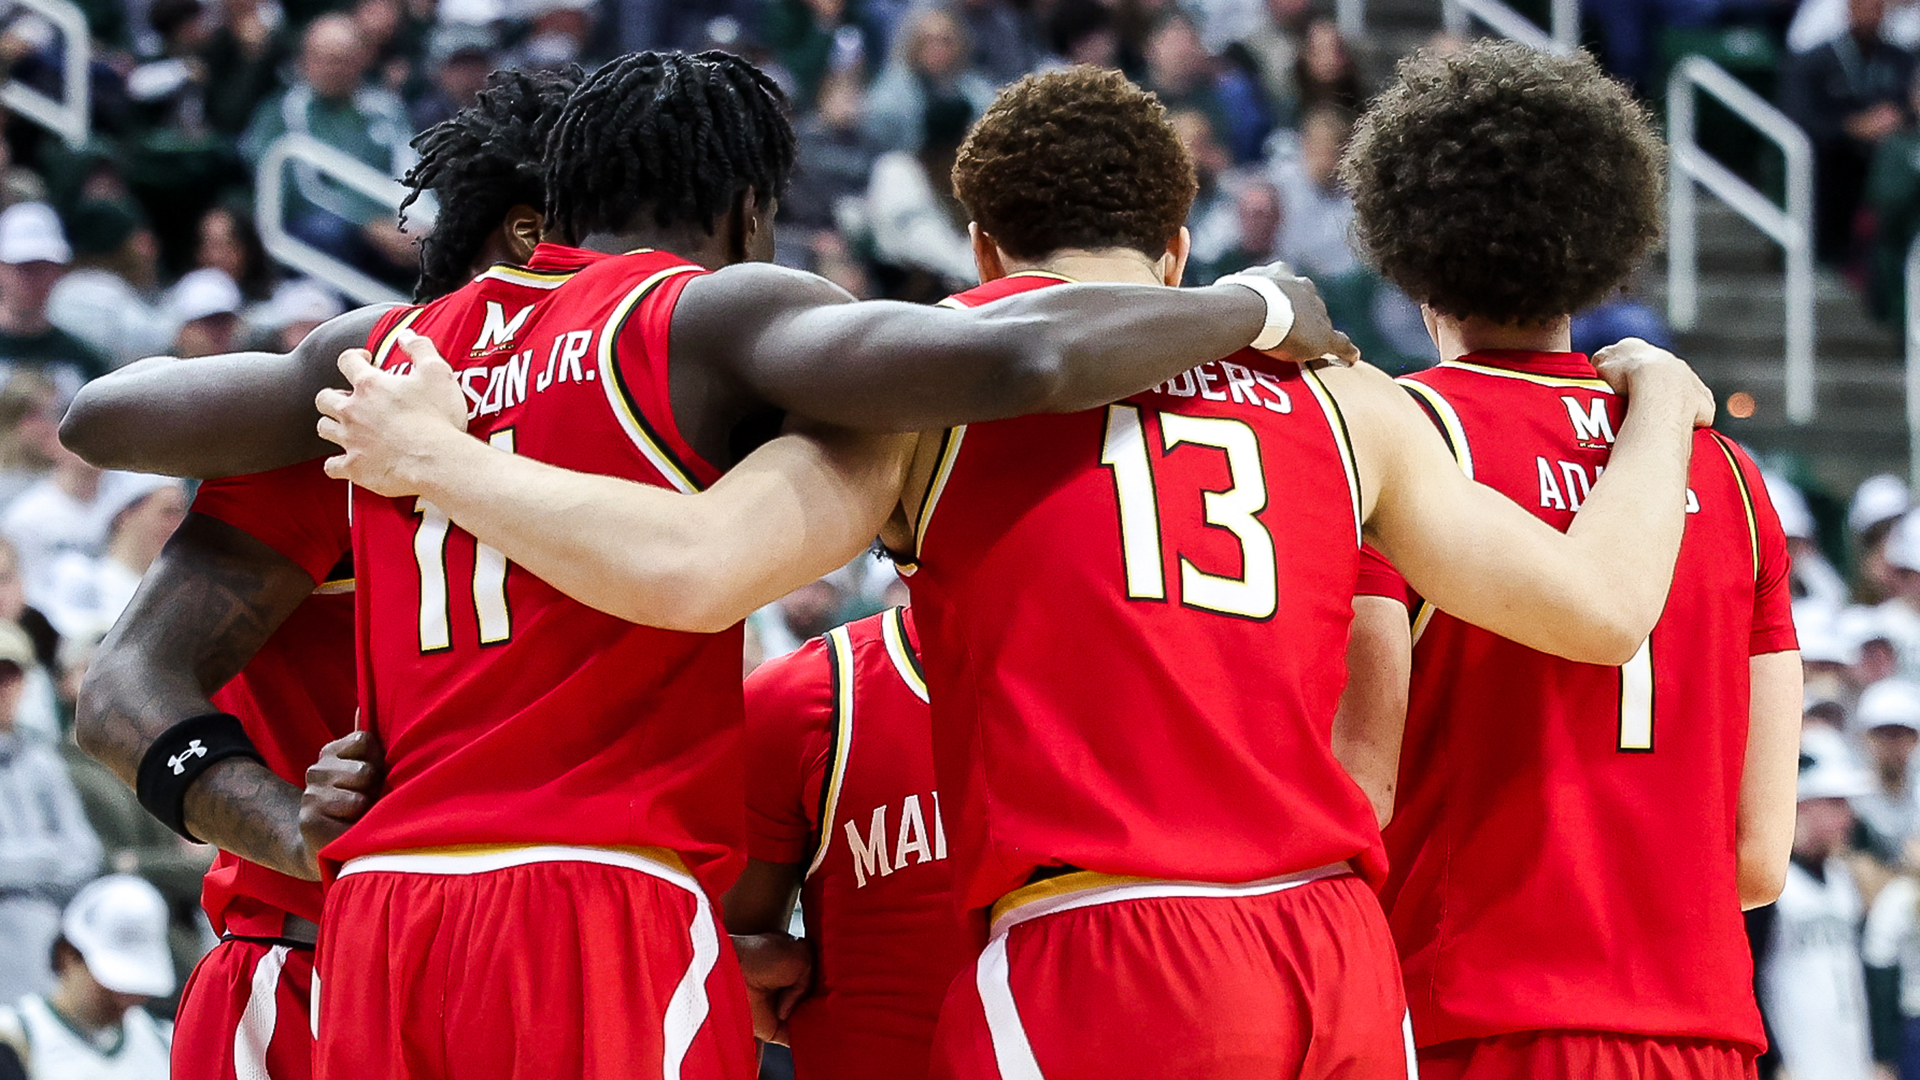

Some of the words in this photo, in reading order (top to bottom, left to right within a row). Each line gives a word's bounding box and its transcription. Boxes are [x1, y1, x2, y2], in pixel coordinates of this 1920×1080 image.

[470, 299, 537, 351] M
[536, 329, 597, 394] JR.
[1152, 360, 1293, 414] DERS
[1560, 395, 1617, 443] M
[1098, 401, 1279, 623] 13
